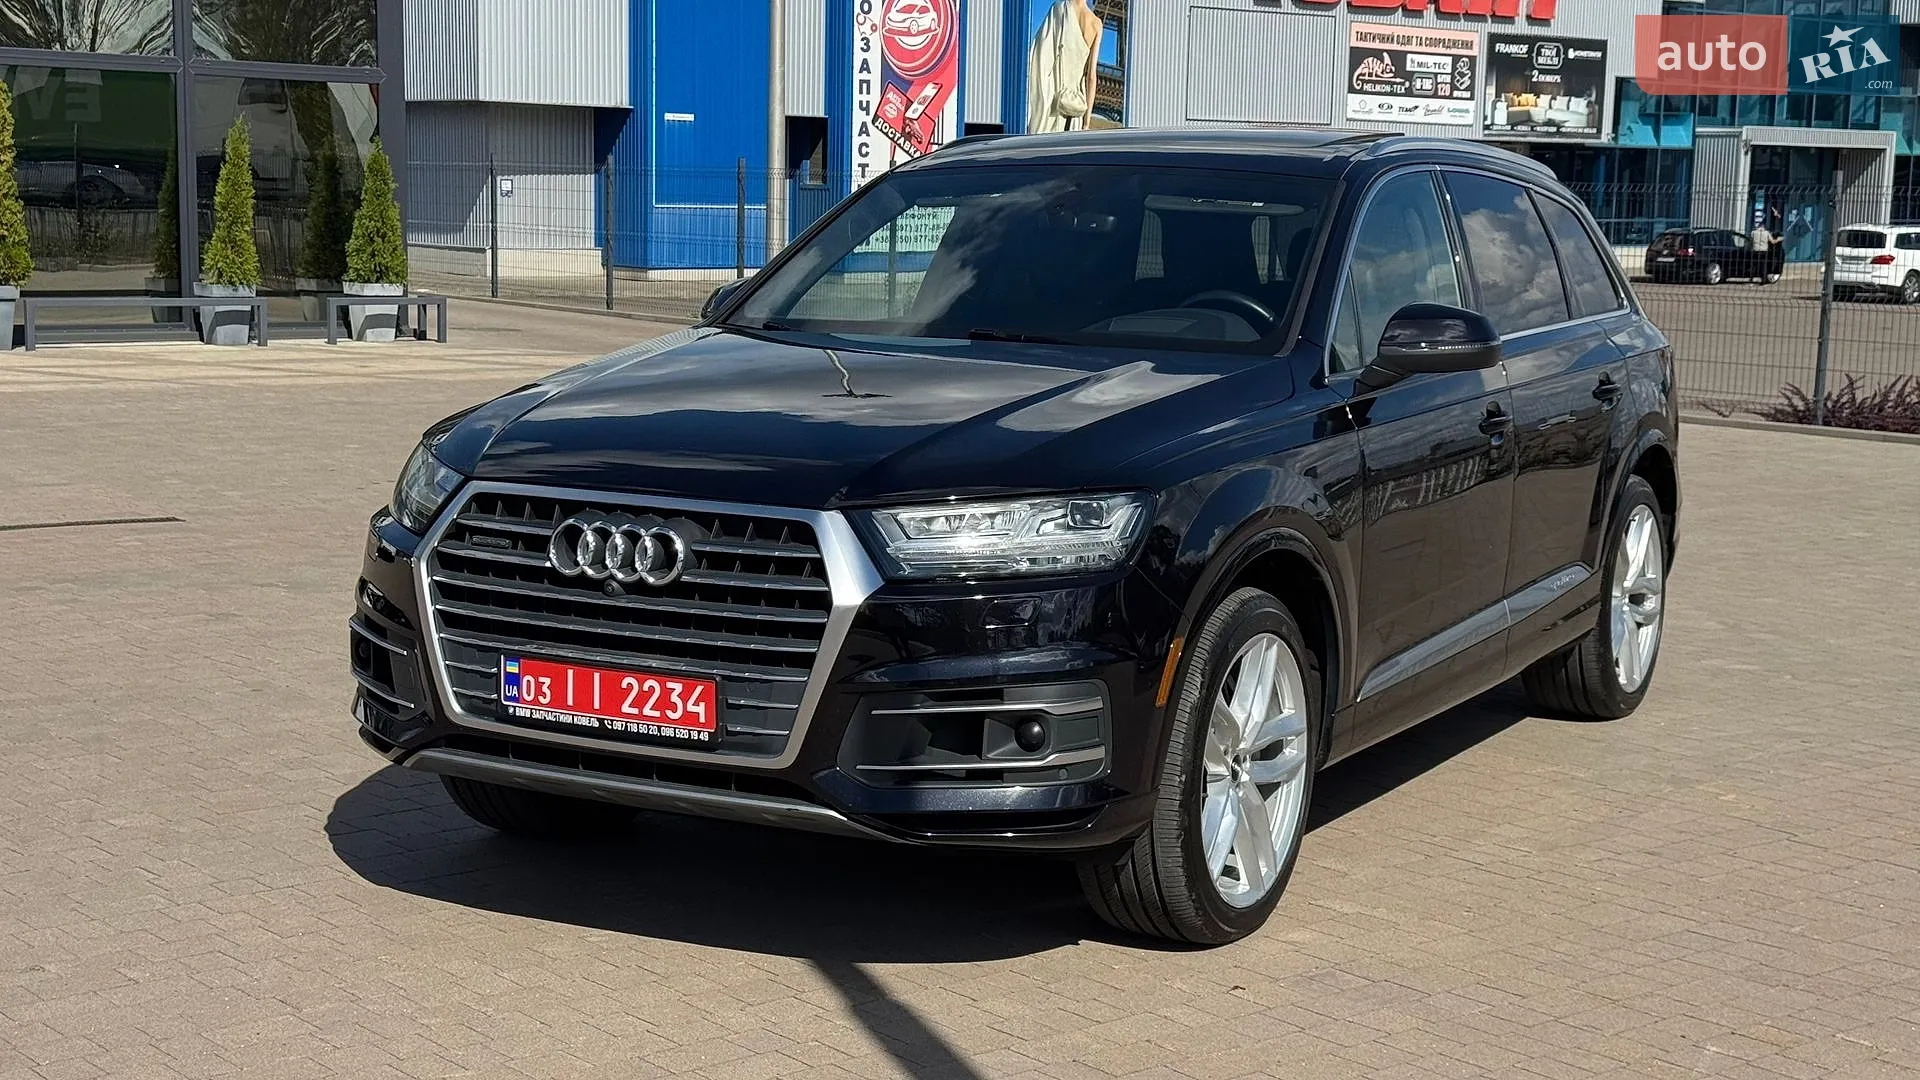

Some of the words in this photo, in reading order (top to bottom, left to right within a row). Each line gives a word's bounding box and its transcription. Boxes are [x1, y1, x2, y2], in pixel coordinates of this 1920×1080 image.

[1415, 36, 1424, 47] ТА
[1416, 61, 1448, 70] MIL-TEC
[1531, 70, 1539, 82] 2
[1363, 82, 1406, 94] HELIKON-TEX
[1437, 83, 1451, 96] 120
[874, 118, 921, 158] ДОСТАВКА
[505, 684, 519, 697] UA
[522, 674, 552, 705] 03
[621, 676, 706, 723] 2234
[573, 715, 600, 728] КОВЕЛЬ
[612, 720, 626, 731] 097
[639, 723, 648, 734] 50
[699, 731, 709, 741] 49
